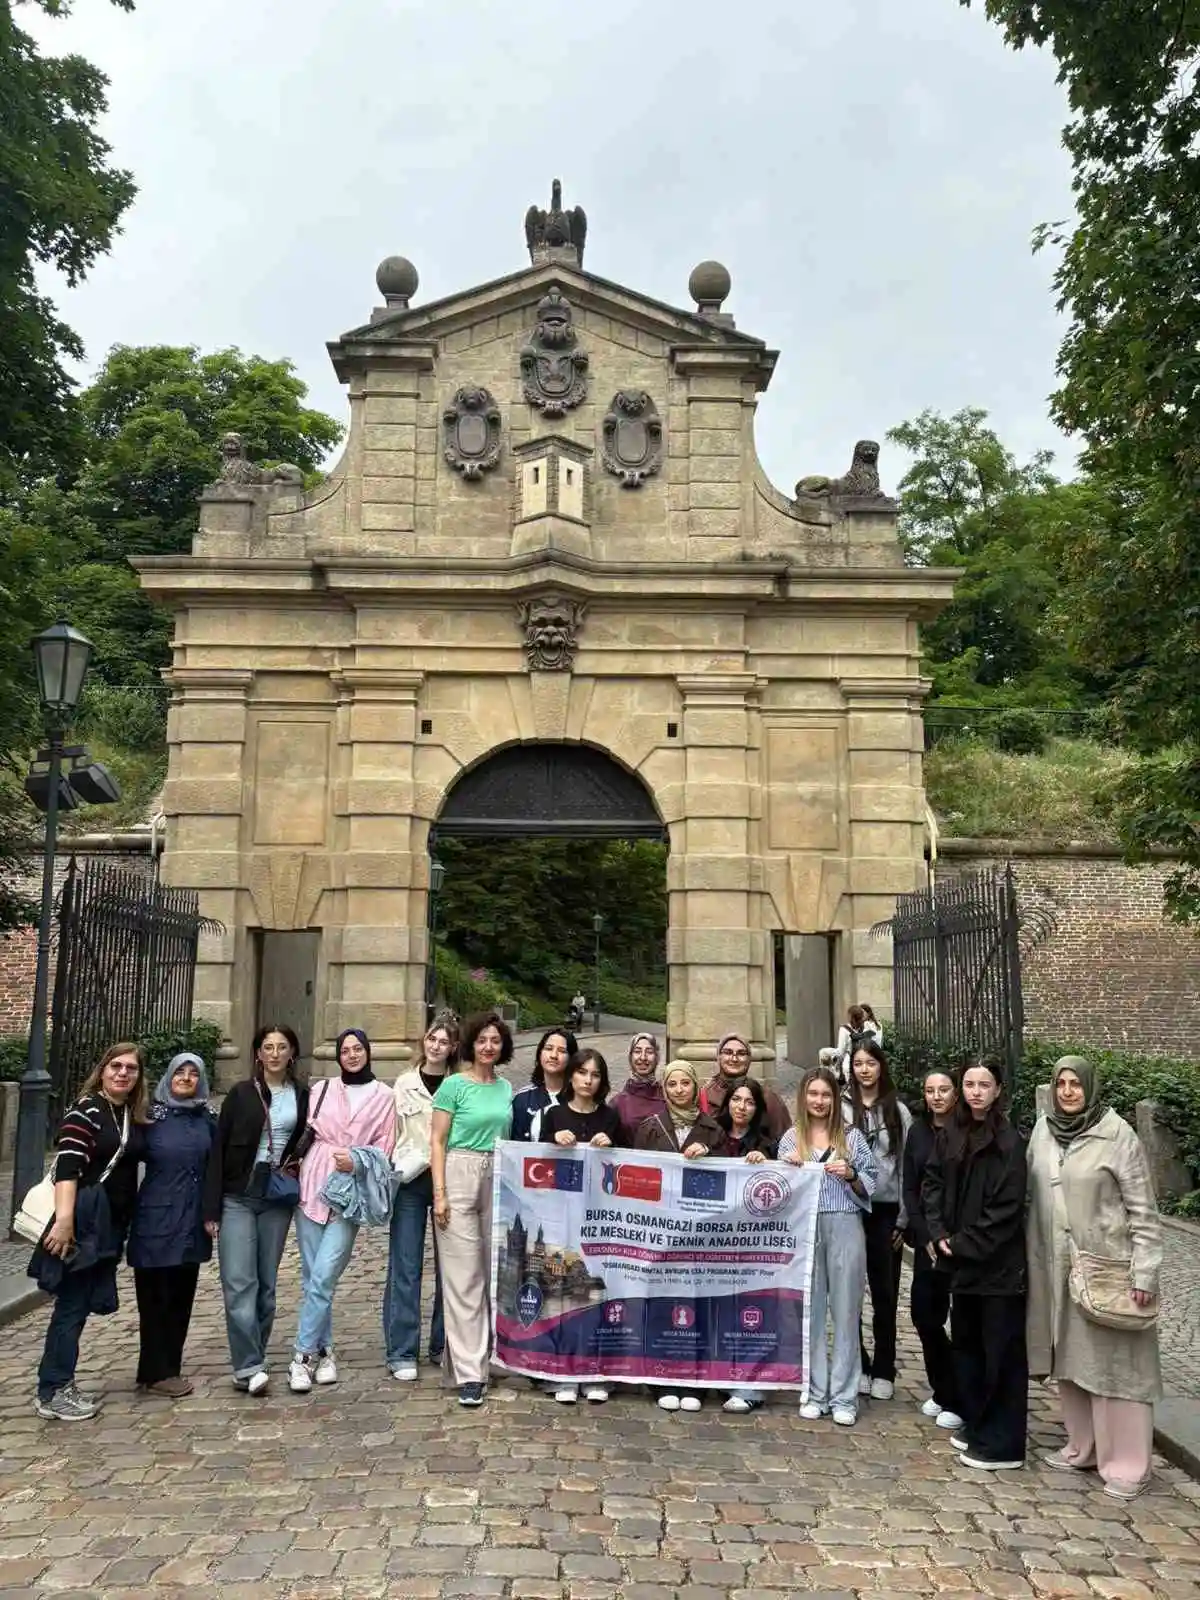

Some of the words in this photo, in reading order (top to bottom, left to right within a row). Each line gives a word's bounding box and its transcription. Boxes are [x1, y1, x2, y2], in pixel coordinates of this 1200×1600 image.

[586, 1208, 622, 1222] BURSA
[626, 1212, 692, 1232] OSMANGAZİ
[696, 1222, 733, 1233] BORSA
[737, 1219, 790, 1233] İSTANBUL
[580, 1226, 598, 1238] KIZ
[600, 1226, 646, 1243] MESLEKİ
[649, 1233, 663, 1245] VE
[666, 1235, 705, 1247] TEKNİK
[708, 1235, 760, 1248] ANADOLU
[763, 1234, 797, 1249] LİSESİ
